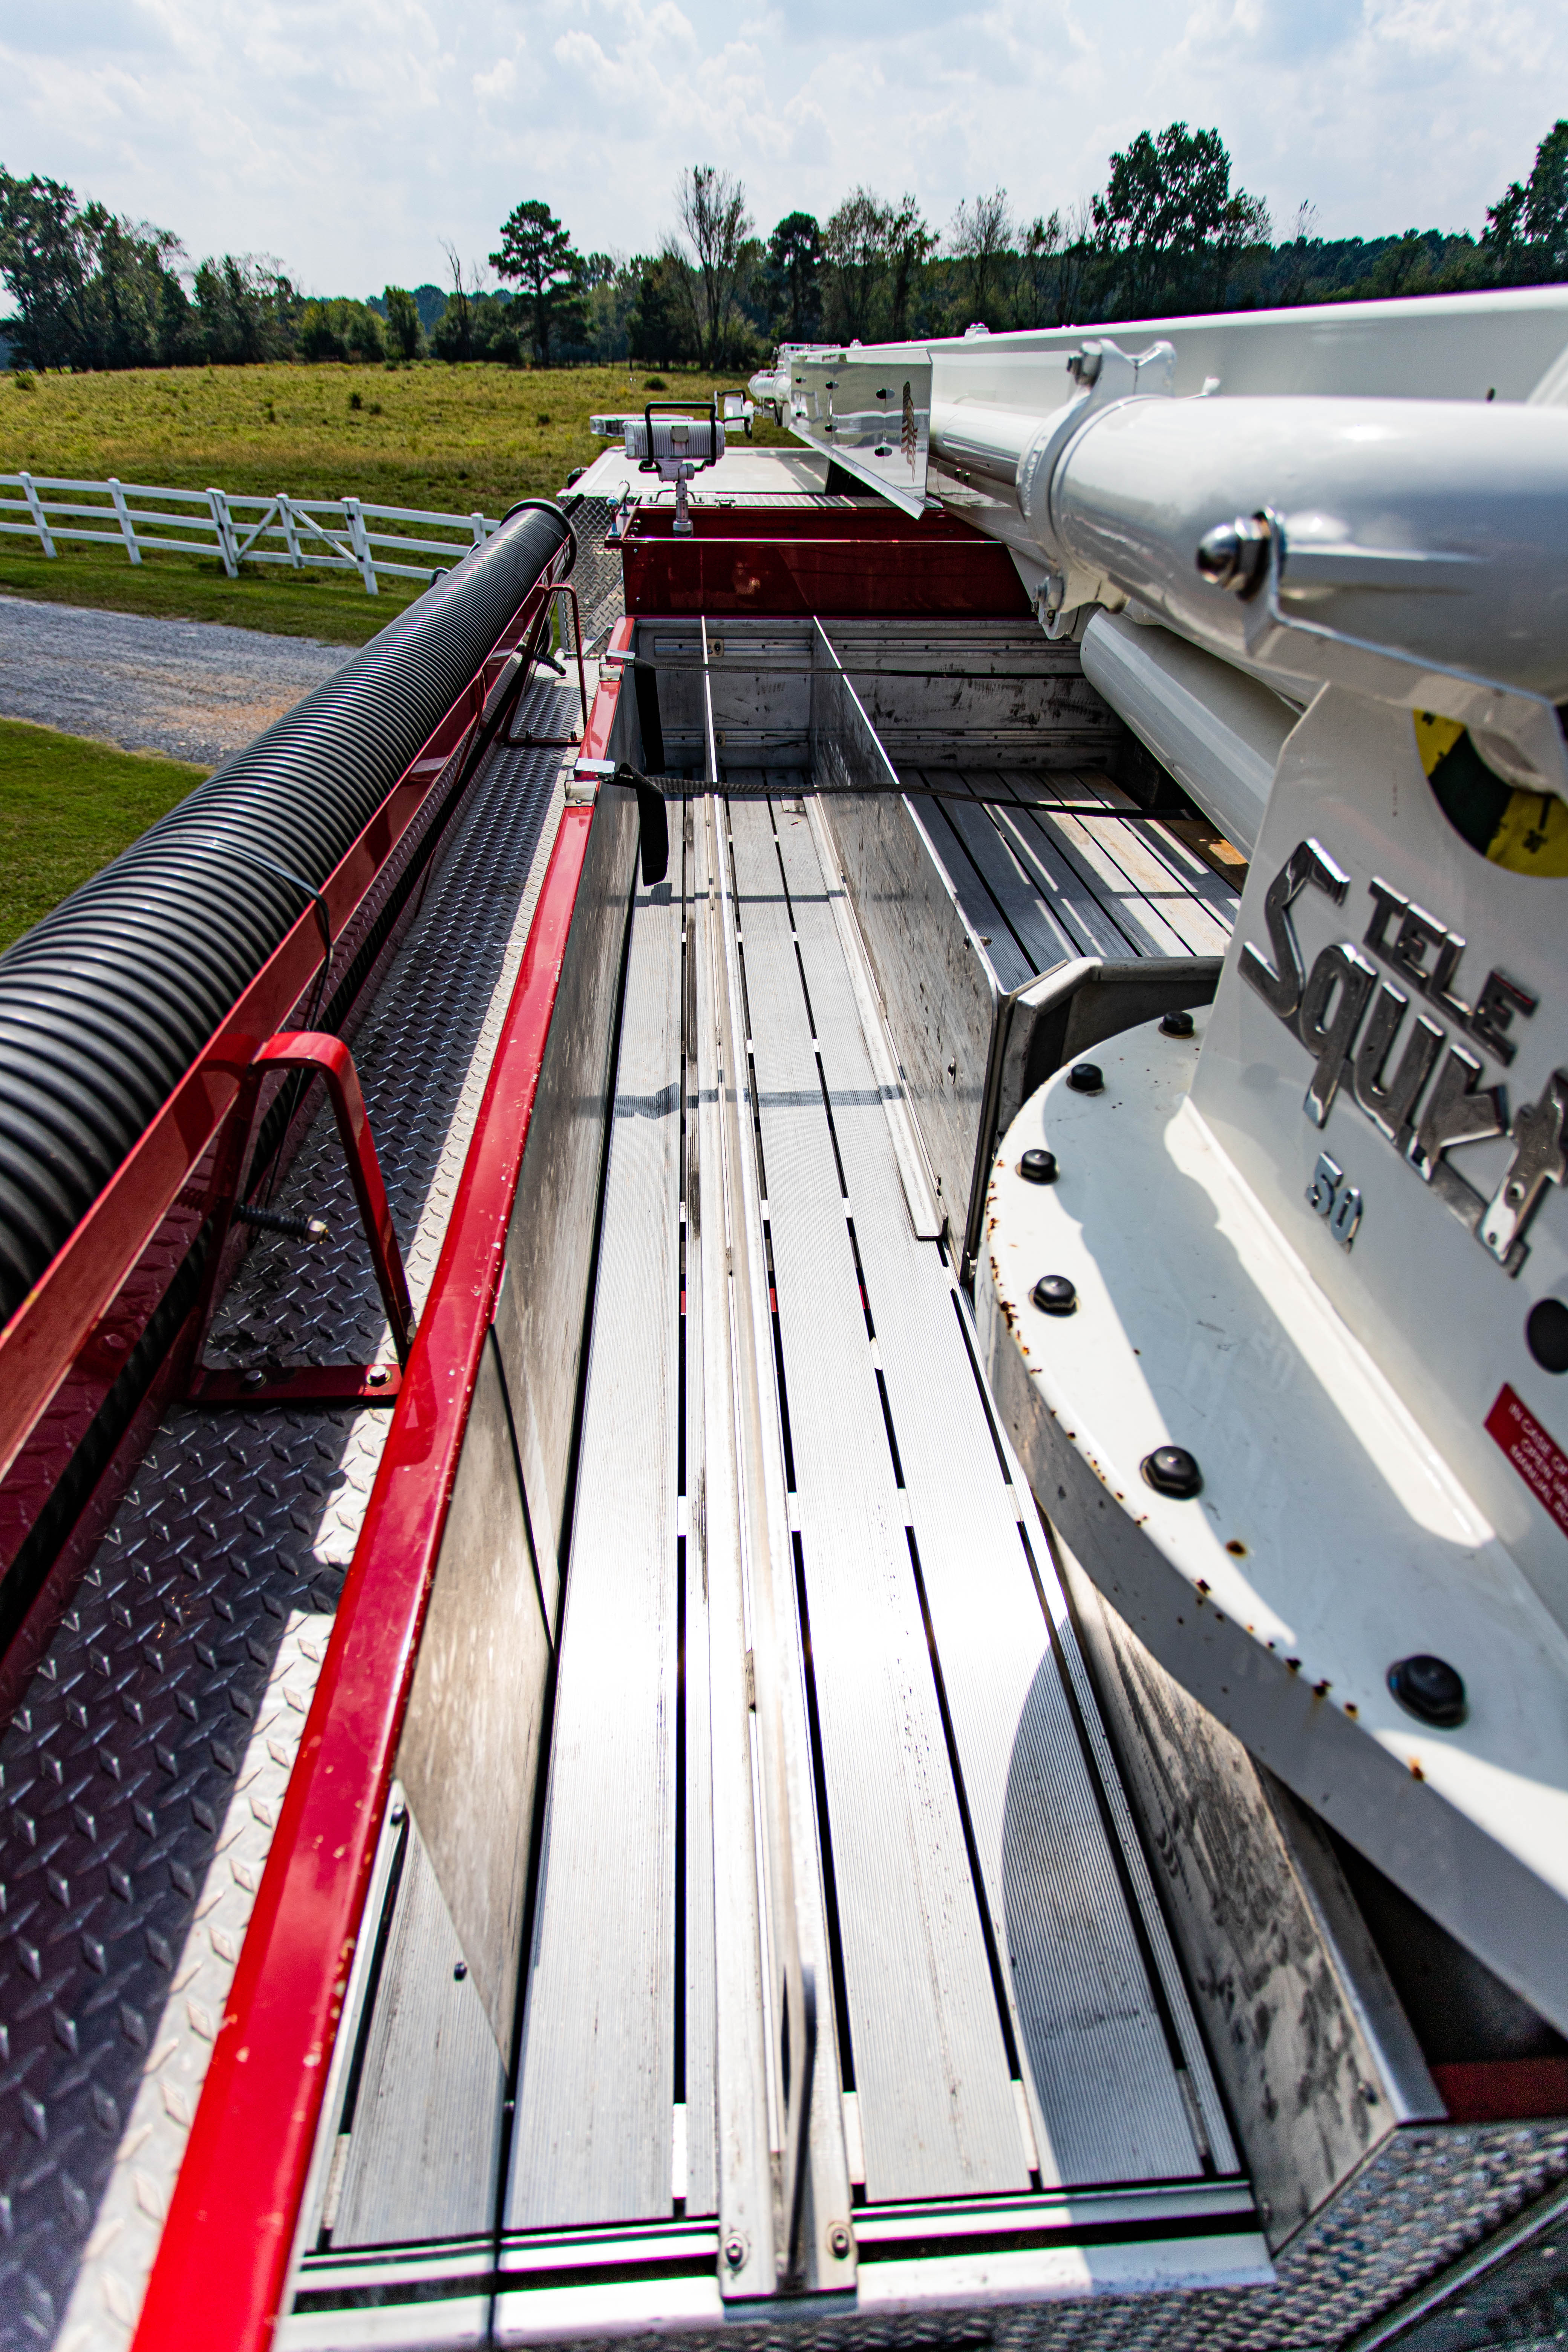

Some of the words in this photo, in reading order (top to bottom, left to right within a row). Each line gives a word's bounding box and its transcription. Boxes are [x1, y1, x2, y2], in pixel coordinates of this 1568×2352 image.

[1363, 875, 1538, 1067] TELE
[1305, 1151, 1362, 1246] 50
[1508, 1403, 1524, 1421] IN
[1510, 1443, 1553, 1503] MANUAL
[1521, 1438, 1553, 1480] OPEN
